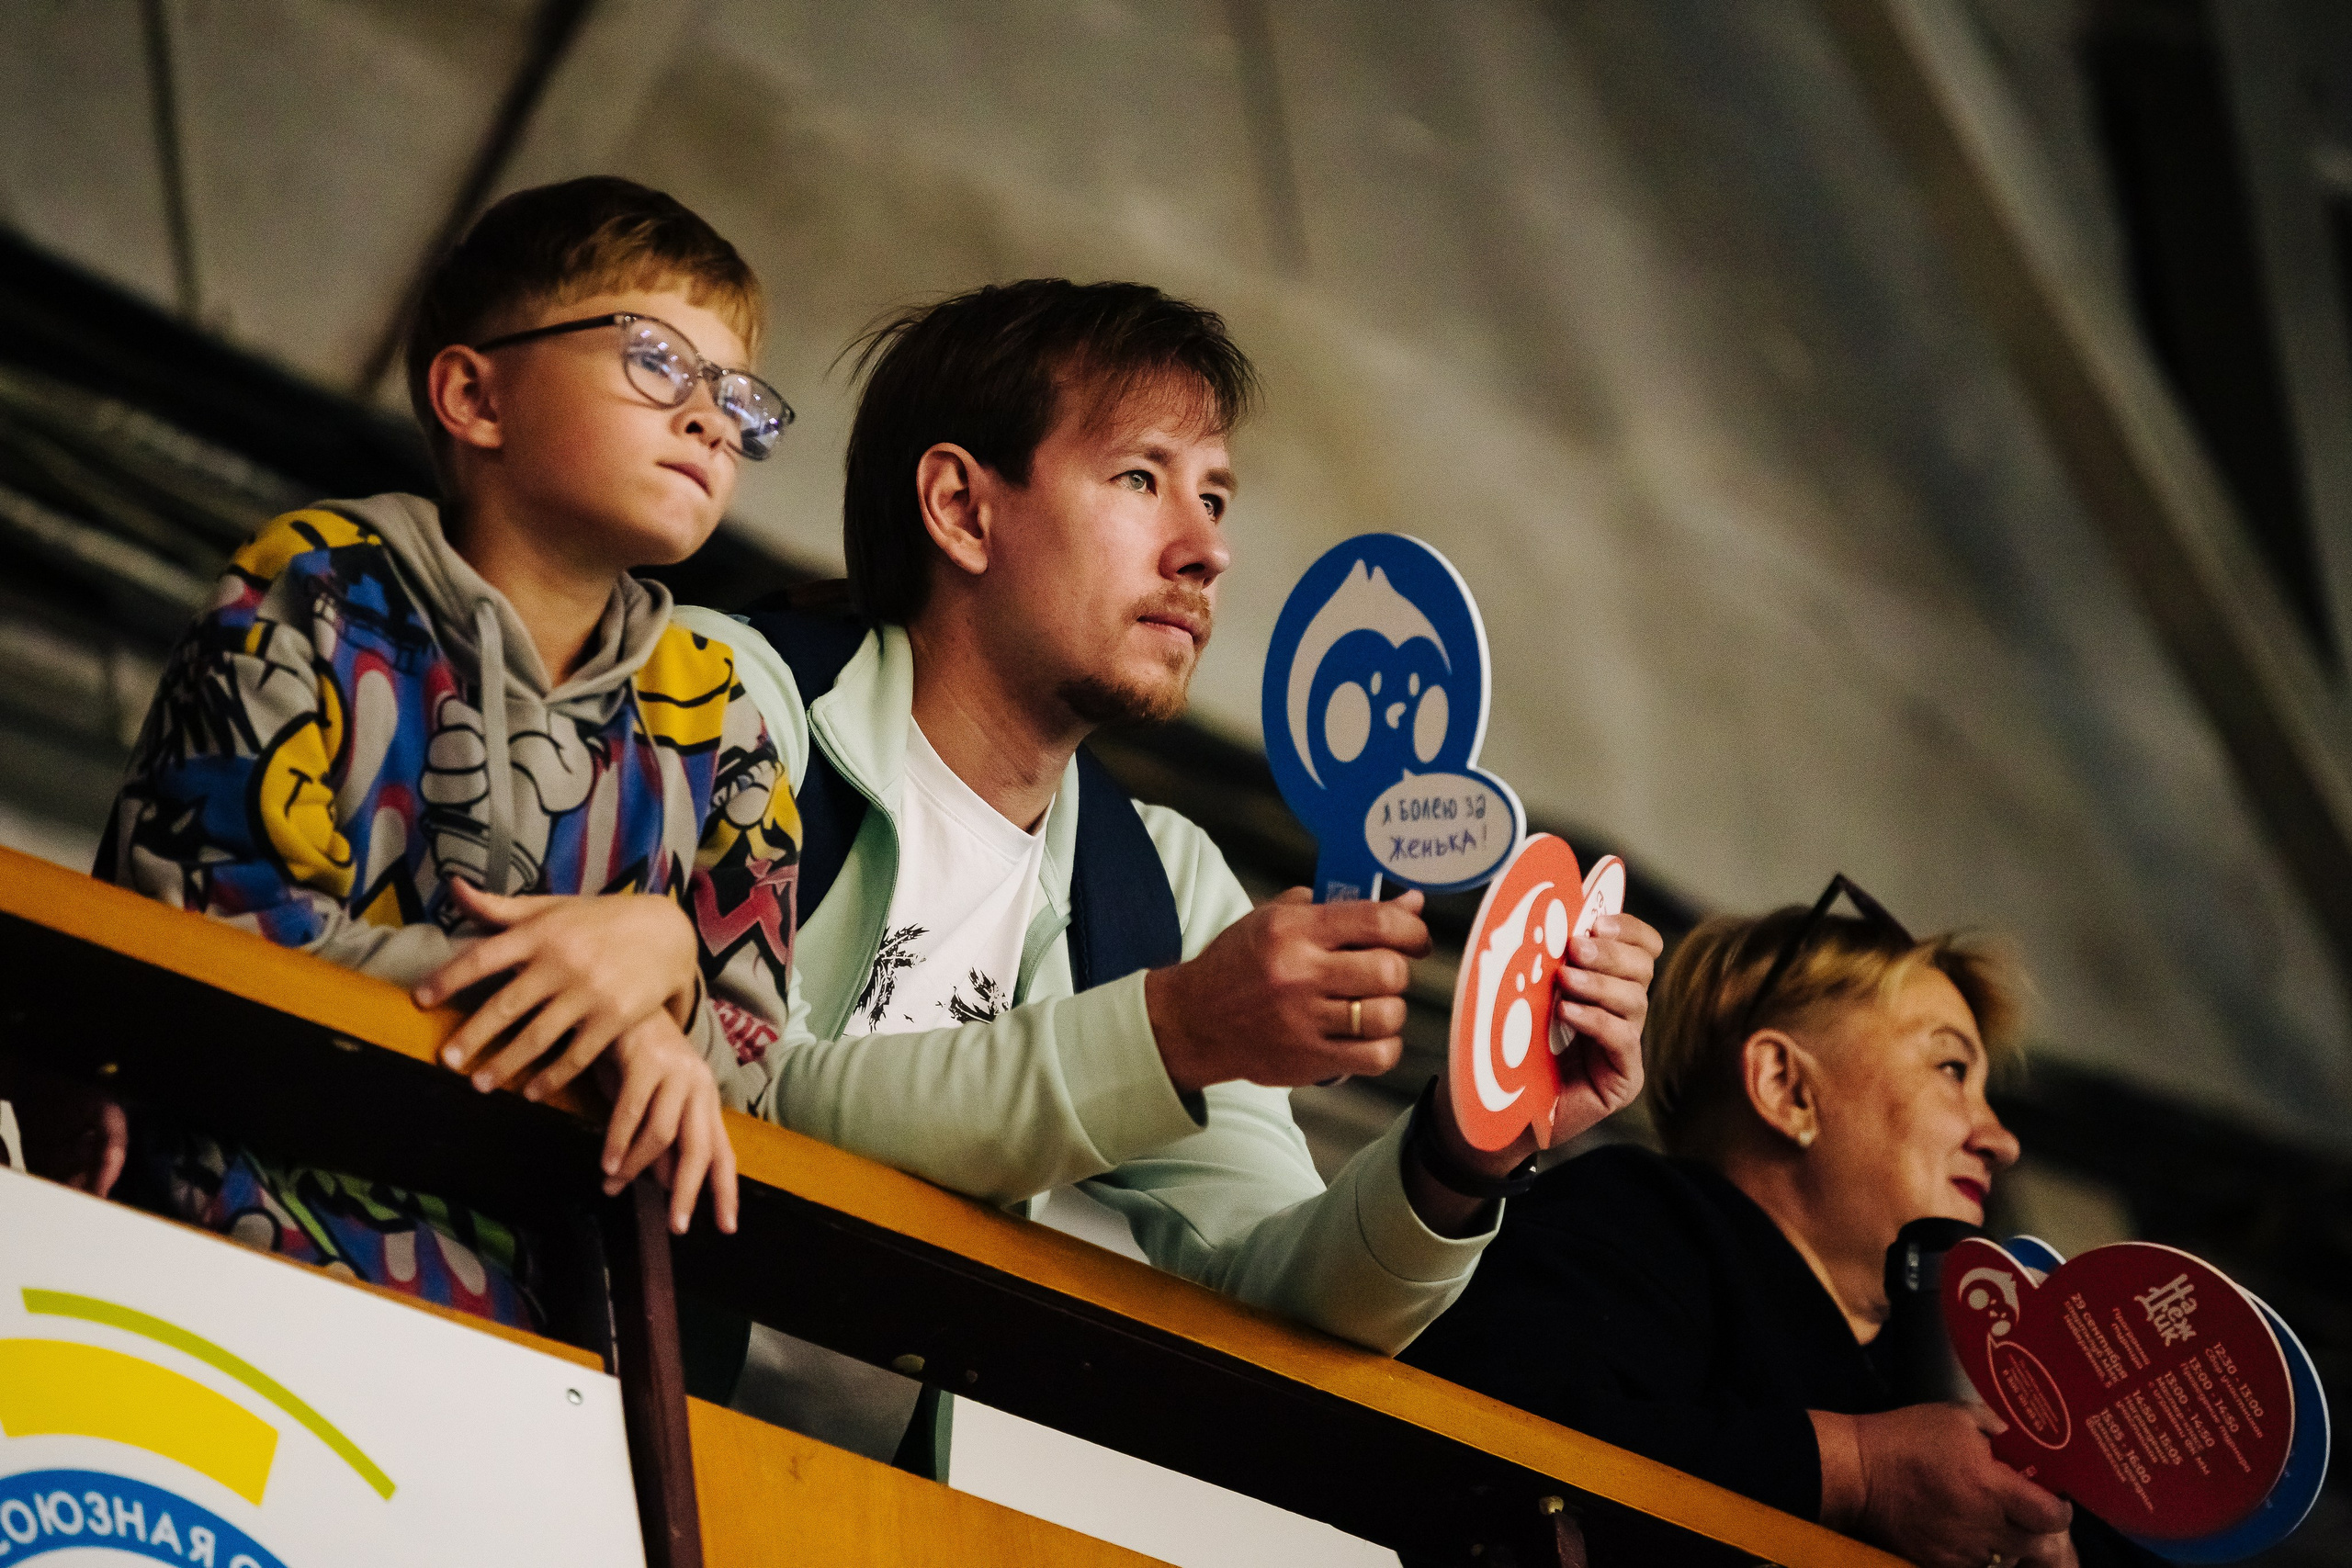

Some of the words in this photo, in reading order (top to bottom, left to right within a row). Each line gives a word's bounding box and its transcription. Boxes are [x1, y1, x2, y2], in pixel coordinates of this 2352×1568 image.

[2070, 1292, 2086, 1311] 29
[2079, 1308, 2131, 1382] сентября
[2163, 1370, 2189, 1406] 13:00
[2188, 1413, 2216, 1449] 14:50
[2187, 1356, 2214, 1391] 13:00
[2213, 1397, 2240, 1434] 14:50
[2211, 1340, 2238, 1376] 12:30
[2237, 1382, 2265, 1418] 13:00
[2098, 1407, 2125, 1441] 15:05
[2124, 1449, 2152, 1485] 16:00
[2131, 1389, 2157, 1425] 14:50
[2157, 1431, 2184, 1466] 15:05
